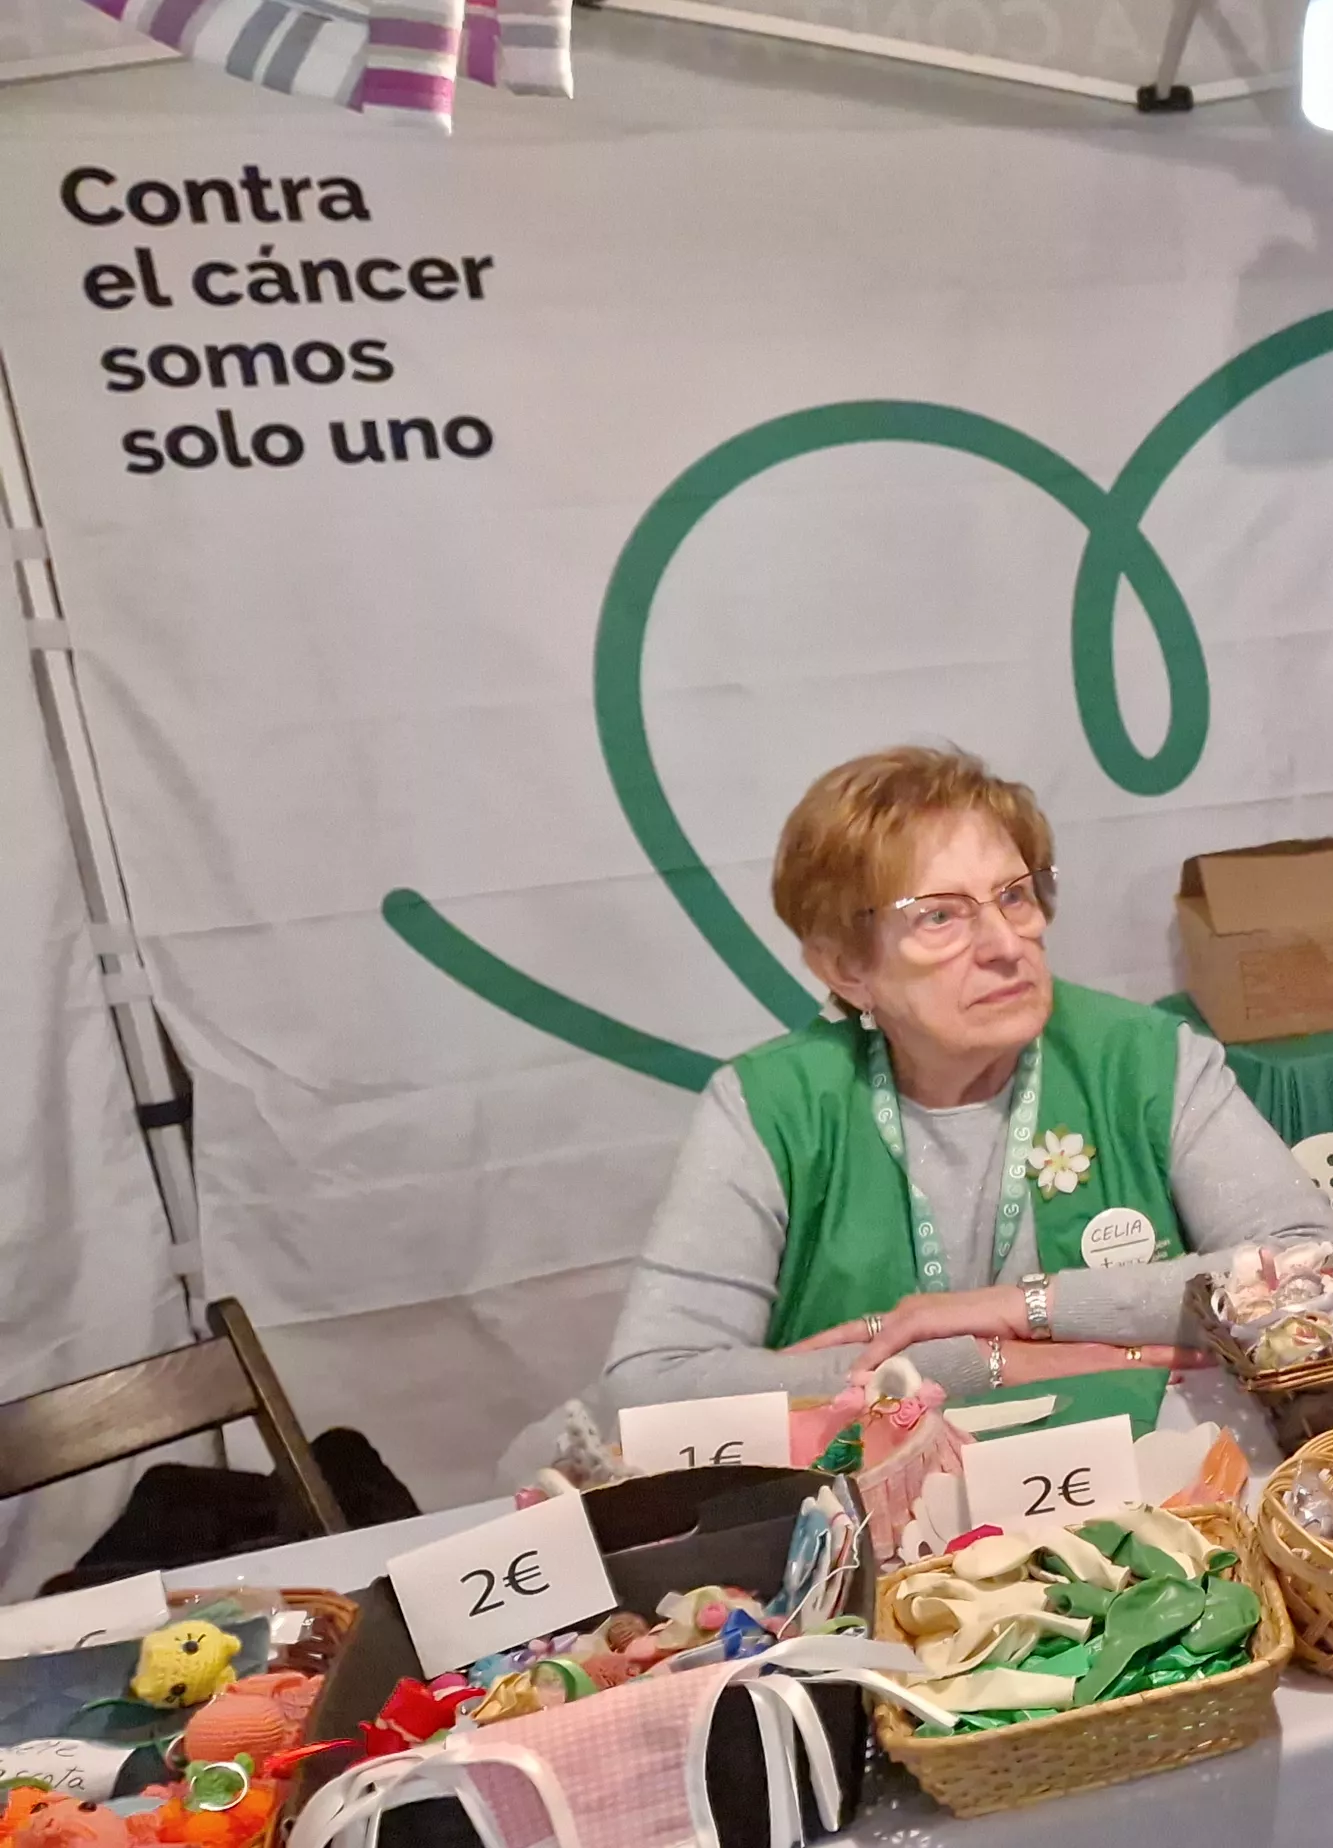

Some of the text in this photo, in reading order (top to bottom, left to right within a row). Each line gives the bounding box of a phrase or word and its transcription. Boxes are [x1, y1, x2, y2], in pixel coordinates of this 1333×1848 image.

[61, 165, 369, 227] Contra
[83, 244, 495, 309] el cáncer
[101, 337, 394, 393] somos
[122, 410, 494, 475] solo uno
[1091, 1219, 1142, 1242] CELIA
[1022, 1467, 1095, 1517] 2€
[460, 1550, 550, 1617] 2€
